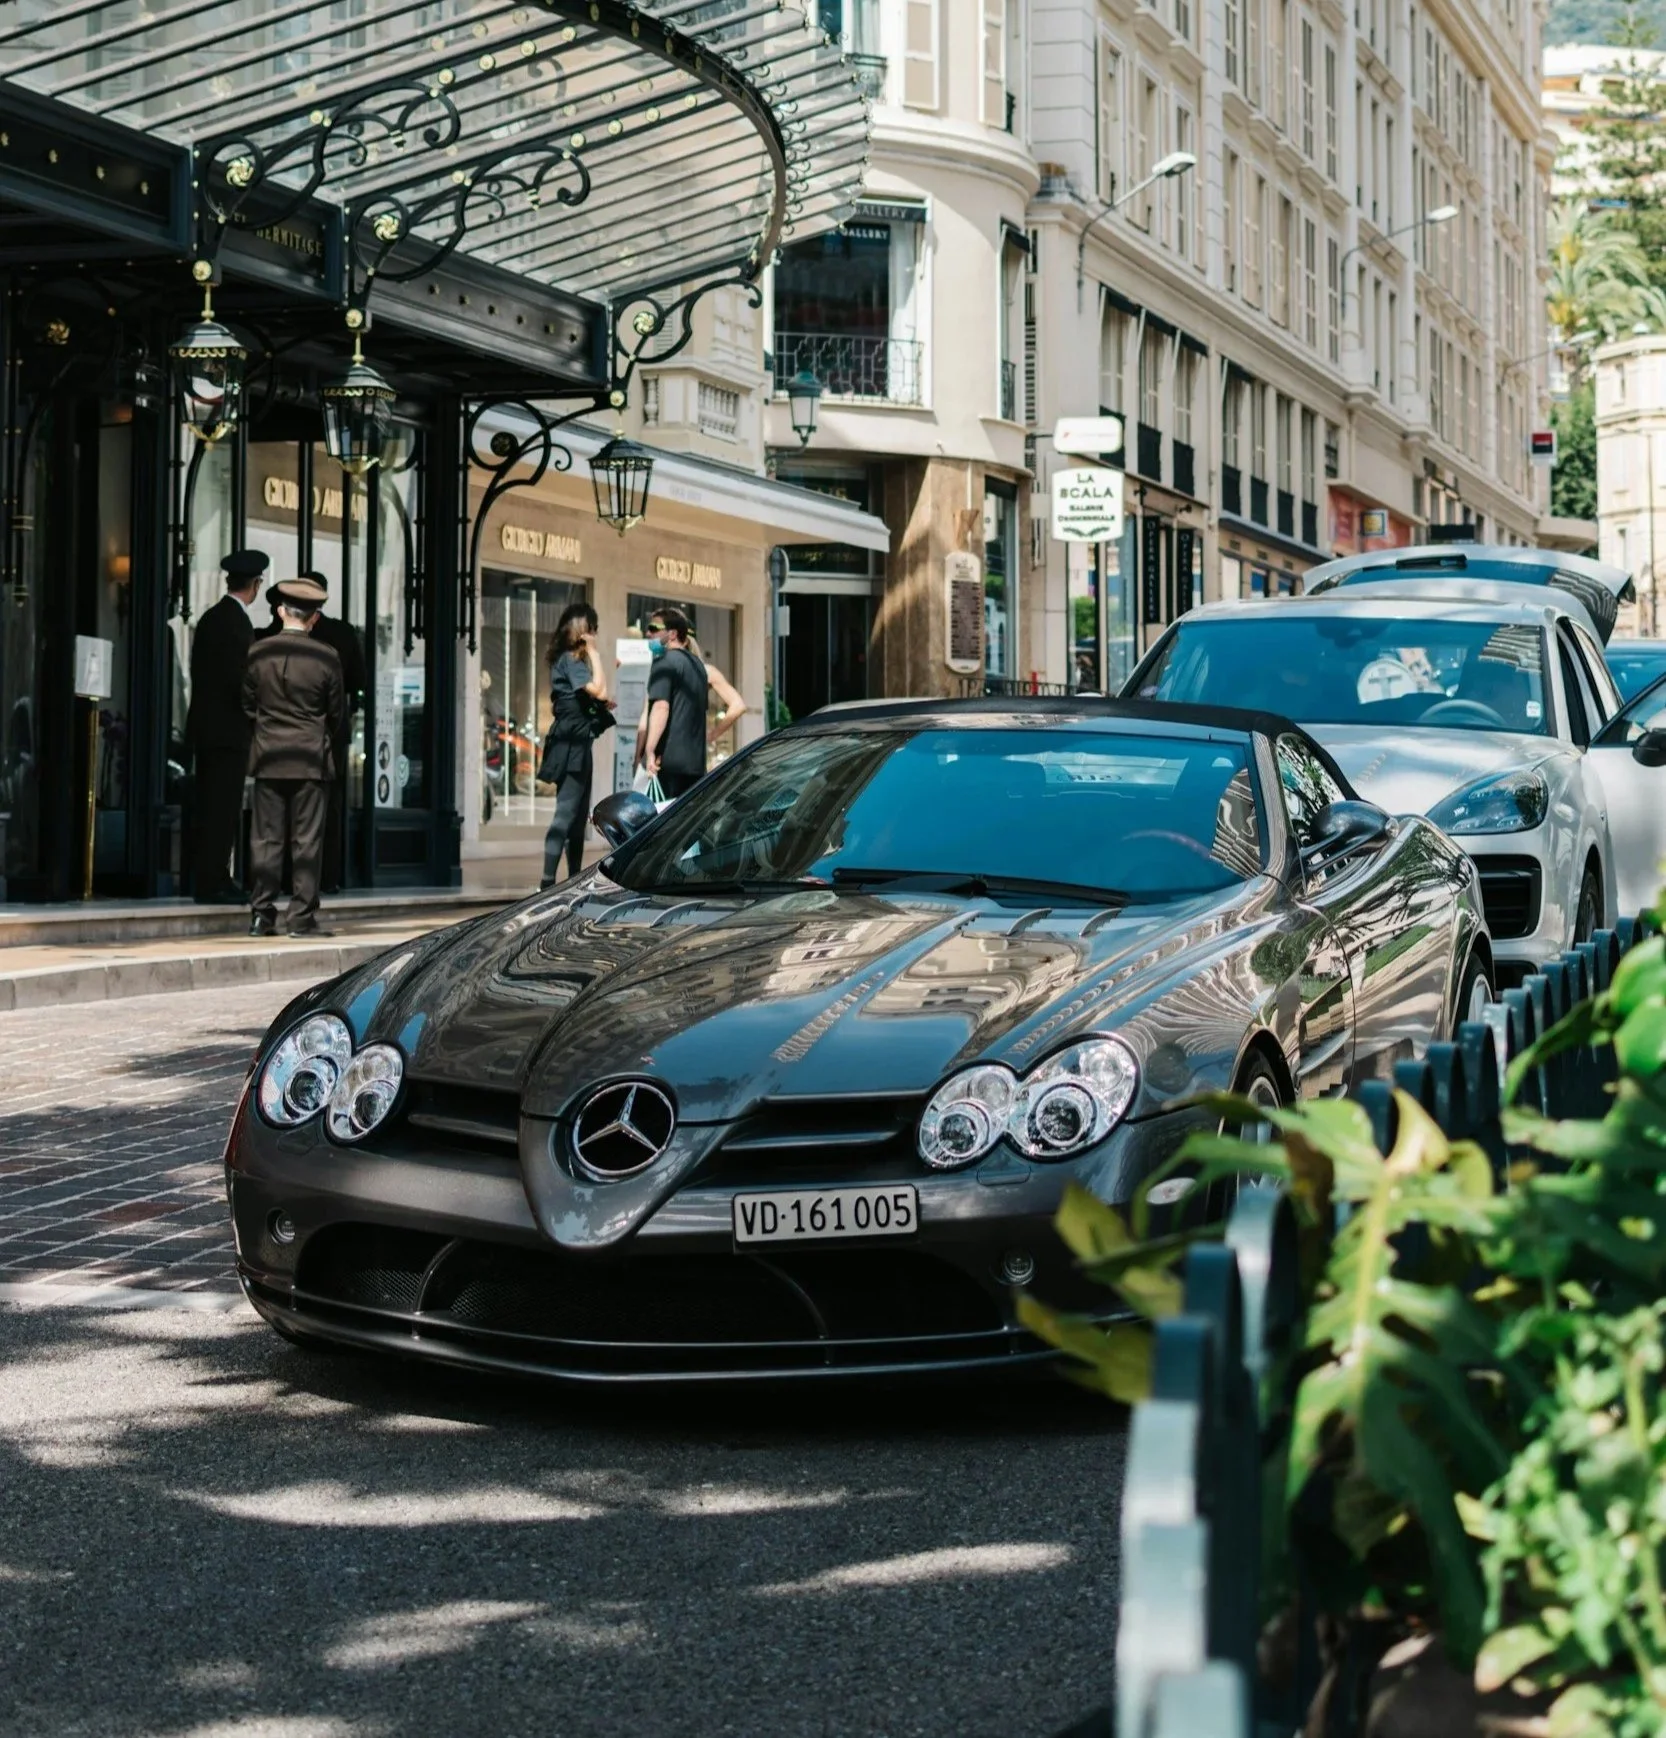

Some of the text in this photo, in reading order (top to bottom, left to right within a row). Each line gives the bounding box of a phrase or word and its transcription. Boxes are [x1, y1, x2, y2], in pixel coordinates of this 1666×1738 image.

[1077, 473, 1095, 483] LA
[1059, 487, 1114, 498] SCALA
[854, 1193, 911, 1230] 005
